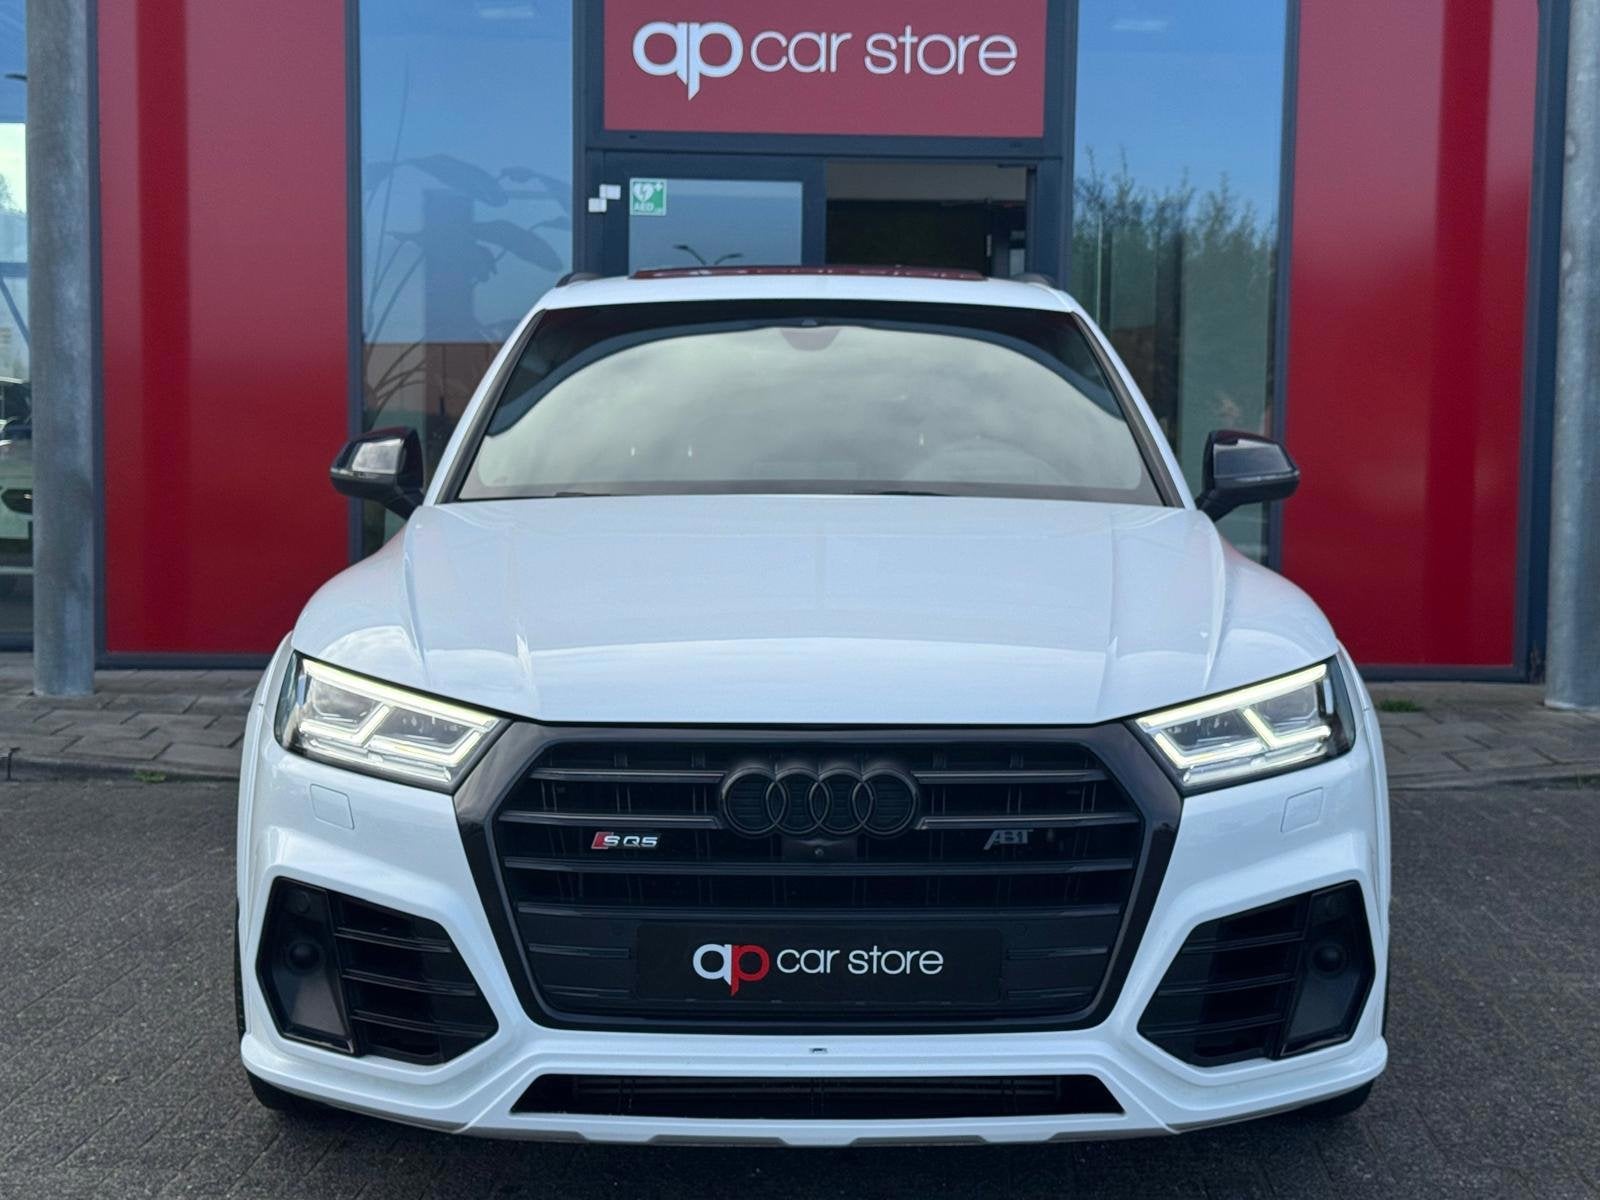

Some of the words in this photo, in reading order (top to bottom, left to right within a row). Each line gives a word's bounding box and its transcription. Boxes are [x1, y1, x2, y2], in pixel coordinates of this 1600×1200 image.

[633, 21, 743, 100] ap
[751, 31, 852, 73] car
[865, 25, 1018, 76] store
[600, 834, 659, 849] SQ5
[983, 829, 1034, 850] ABT
[693, 943, 770, 997] ap
[777, 948, 840, 974] car
[848, 945, 944, 975] store
